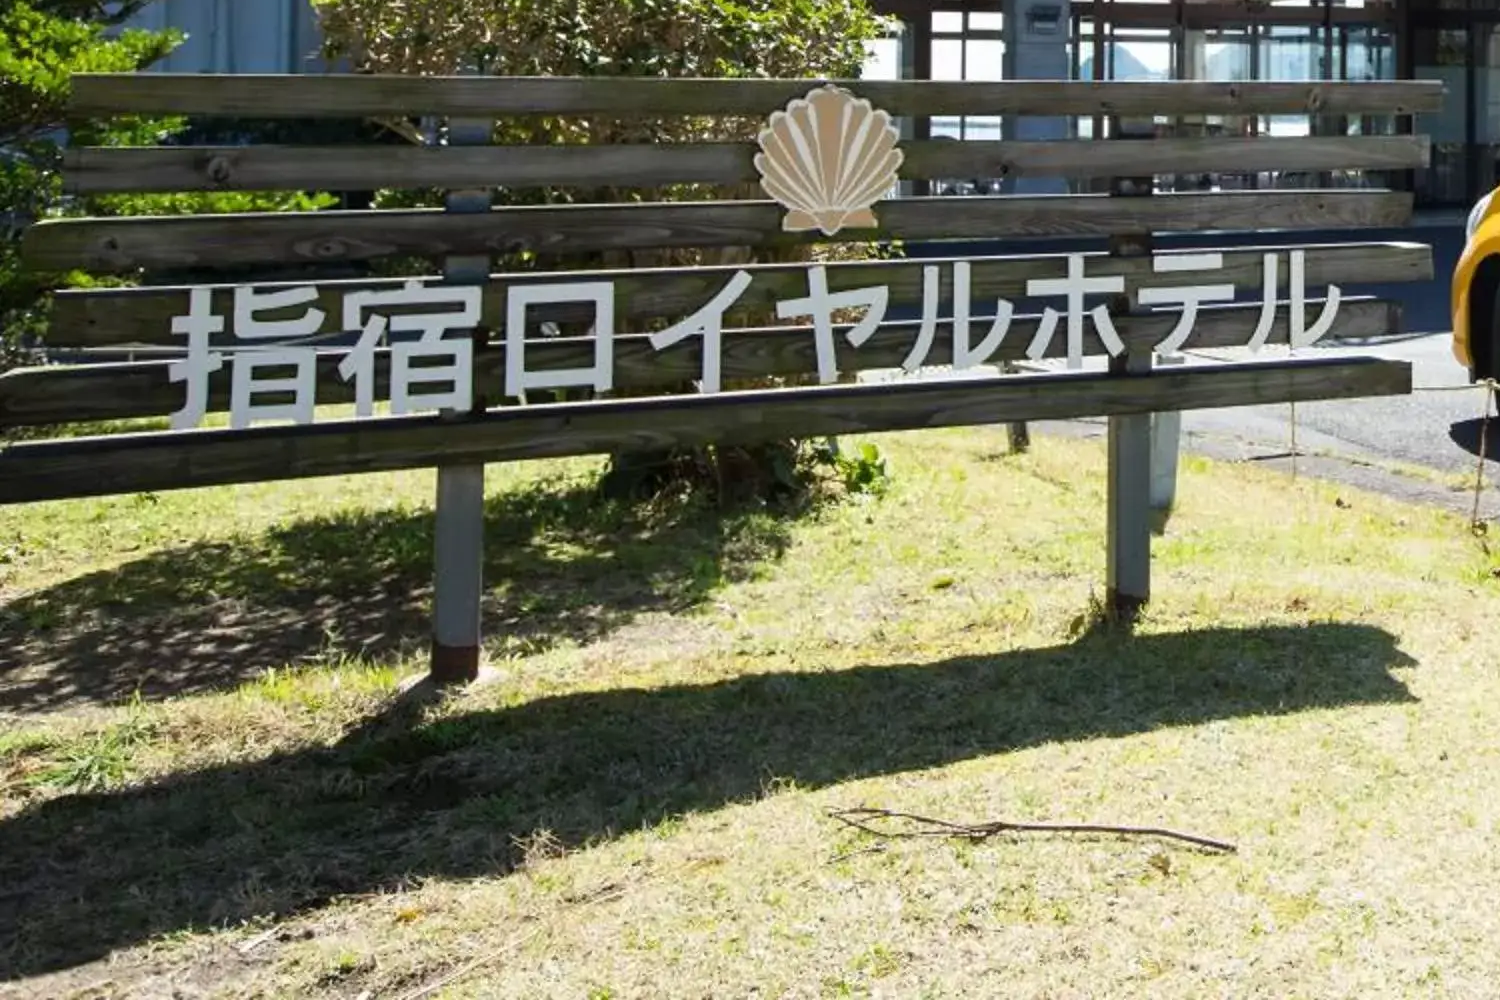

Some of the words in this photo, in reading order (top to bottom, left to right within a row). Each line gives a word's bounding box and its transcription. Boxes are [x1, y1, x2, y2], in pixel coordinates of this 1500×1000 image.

[169, 250, 1341, 429] 指宿ロイヤルホテル
